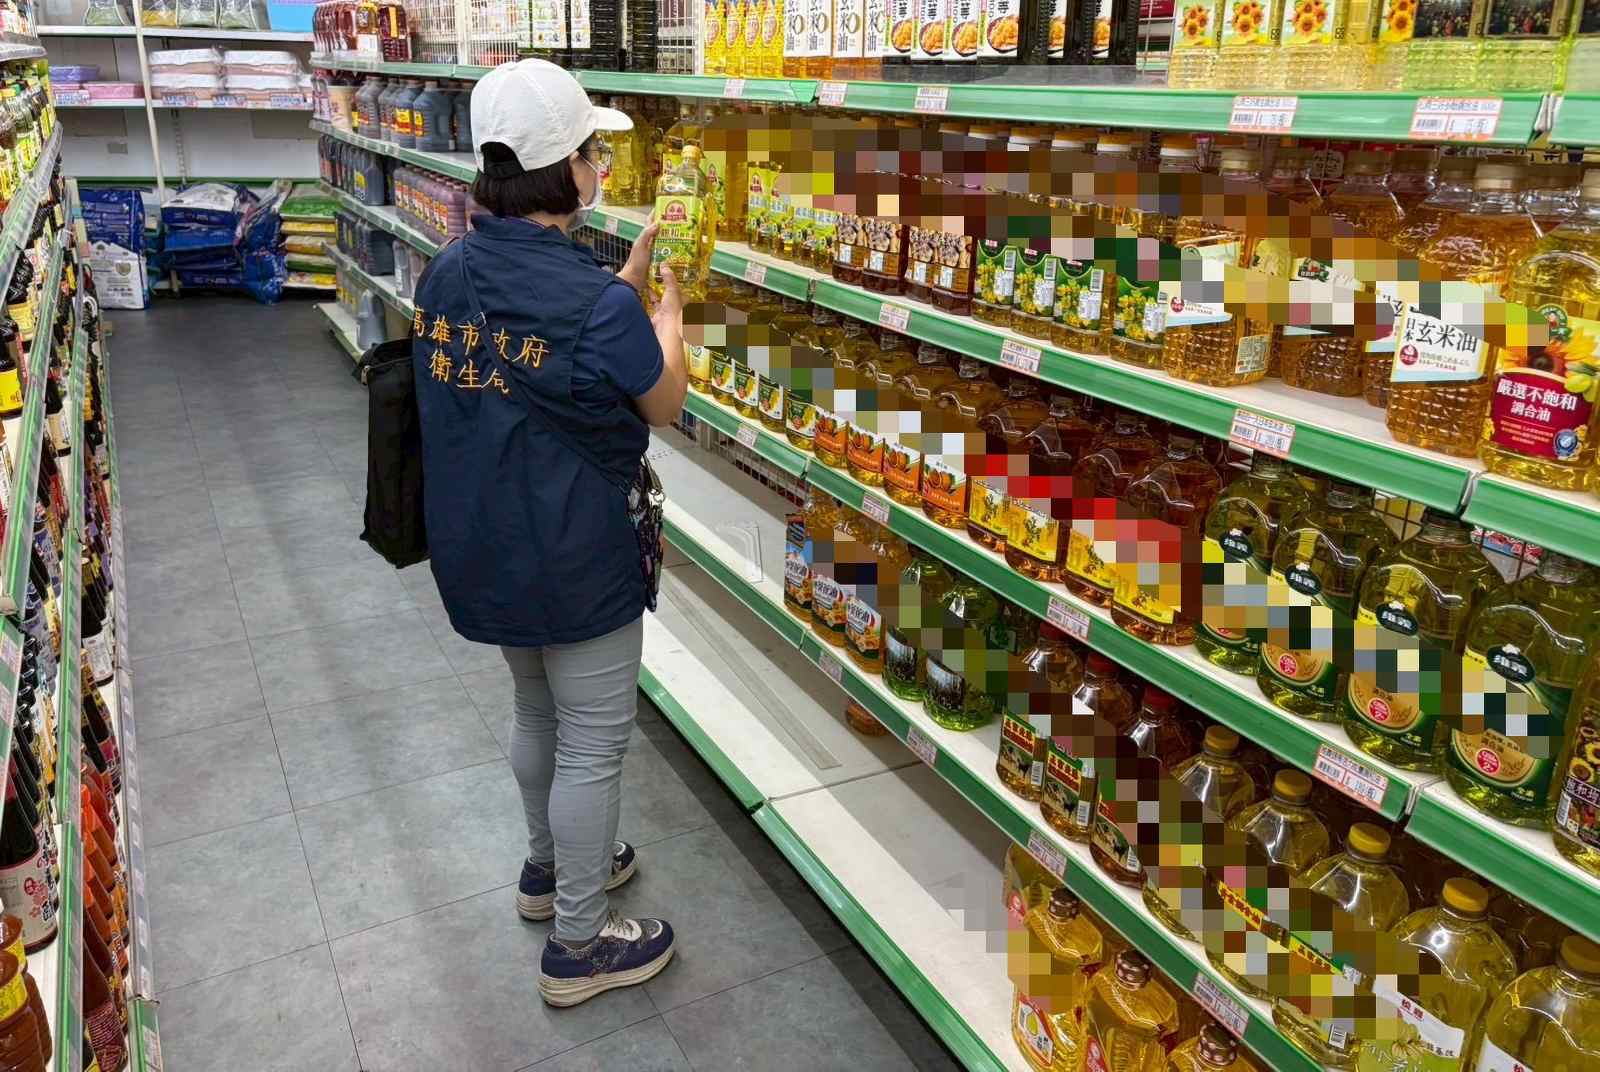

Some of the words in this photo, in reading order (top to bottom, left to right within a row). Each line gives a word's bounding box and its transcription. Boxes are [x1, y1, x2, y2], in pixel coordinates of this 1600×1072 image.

[1416, 321, 1477, 353] 玄米油
[1497, 378, 1577, 411] 嚴選不飽和
[1511, 400, 1551, 423] 調合油
